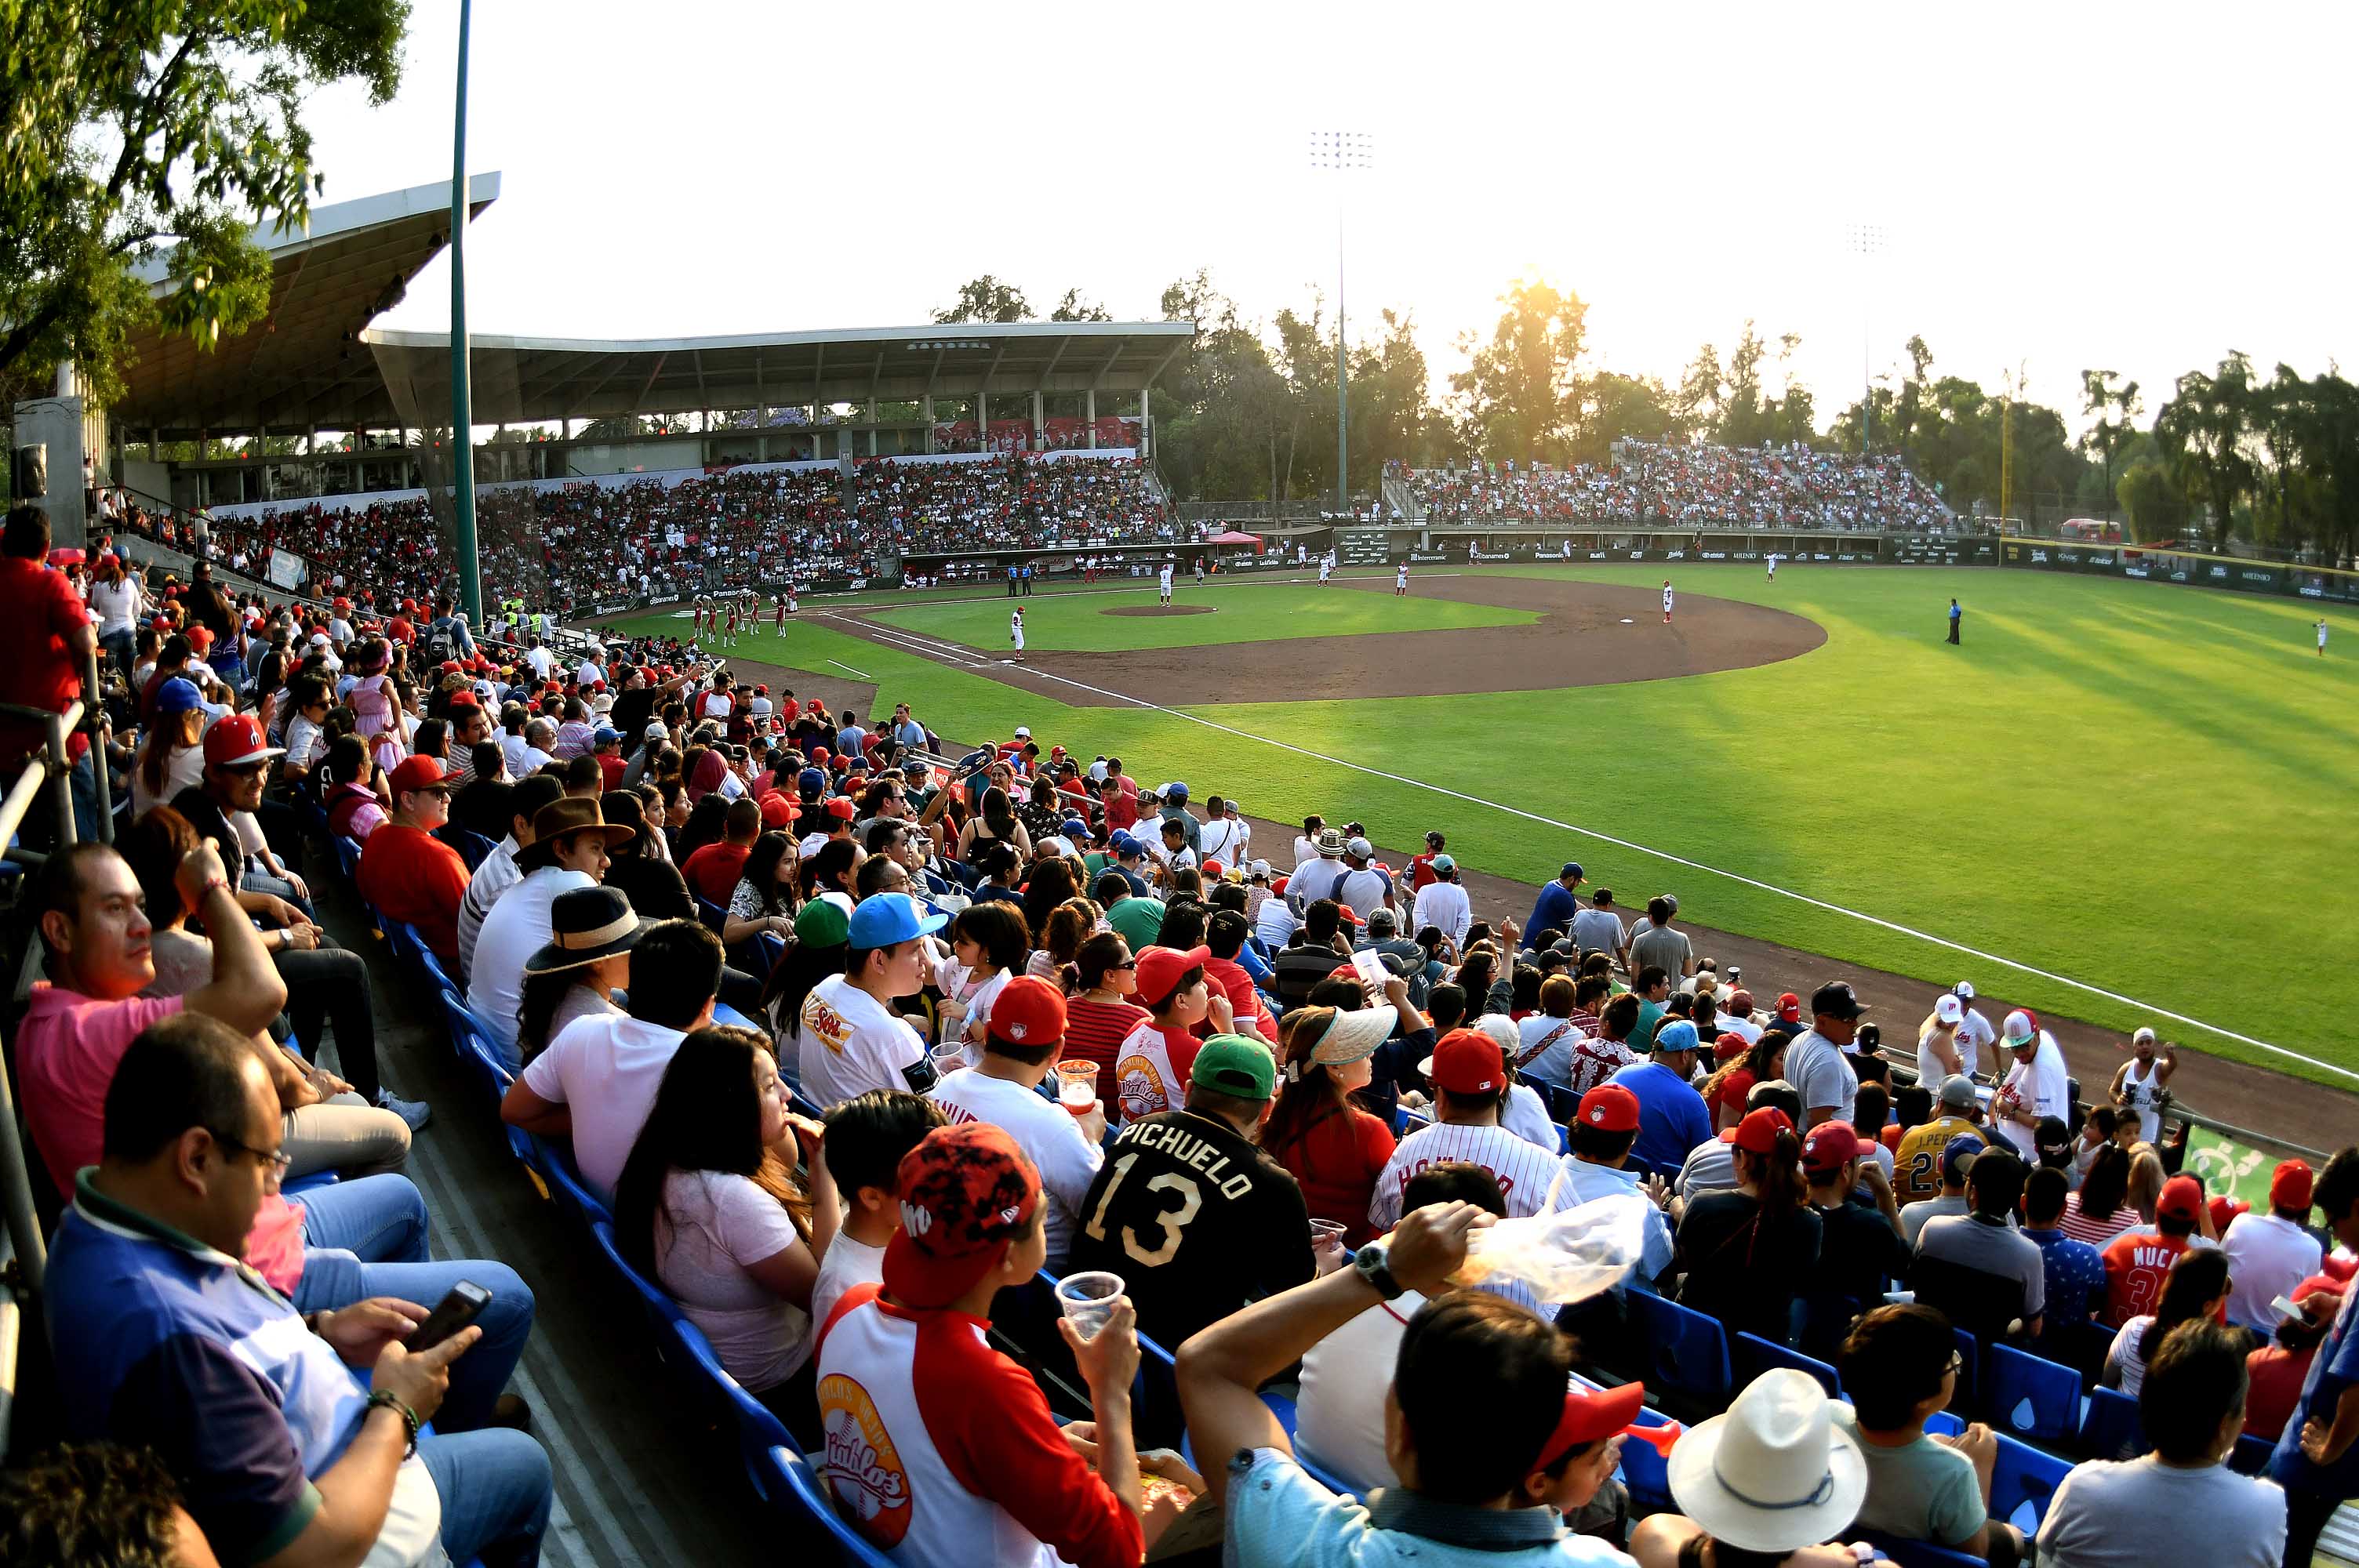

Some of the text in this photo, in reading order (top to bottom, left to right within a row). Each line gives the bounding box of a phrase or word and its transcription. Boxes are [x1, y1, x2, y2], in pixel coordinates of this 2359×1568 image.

[2242, 572, 2271, 582] MILENIO
[1114, 1122, 1253, 1200] PICHUELO
[1085, 1152, 1202, 1268] 13
[827, 1432, 902, 1497] iablos
